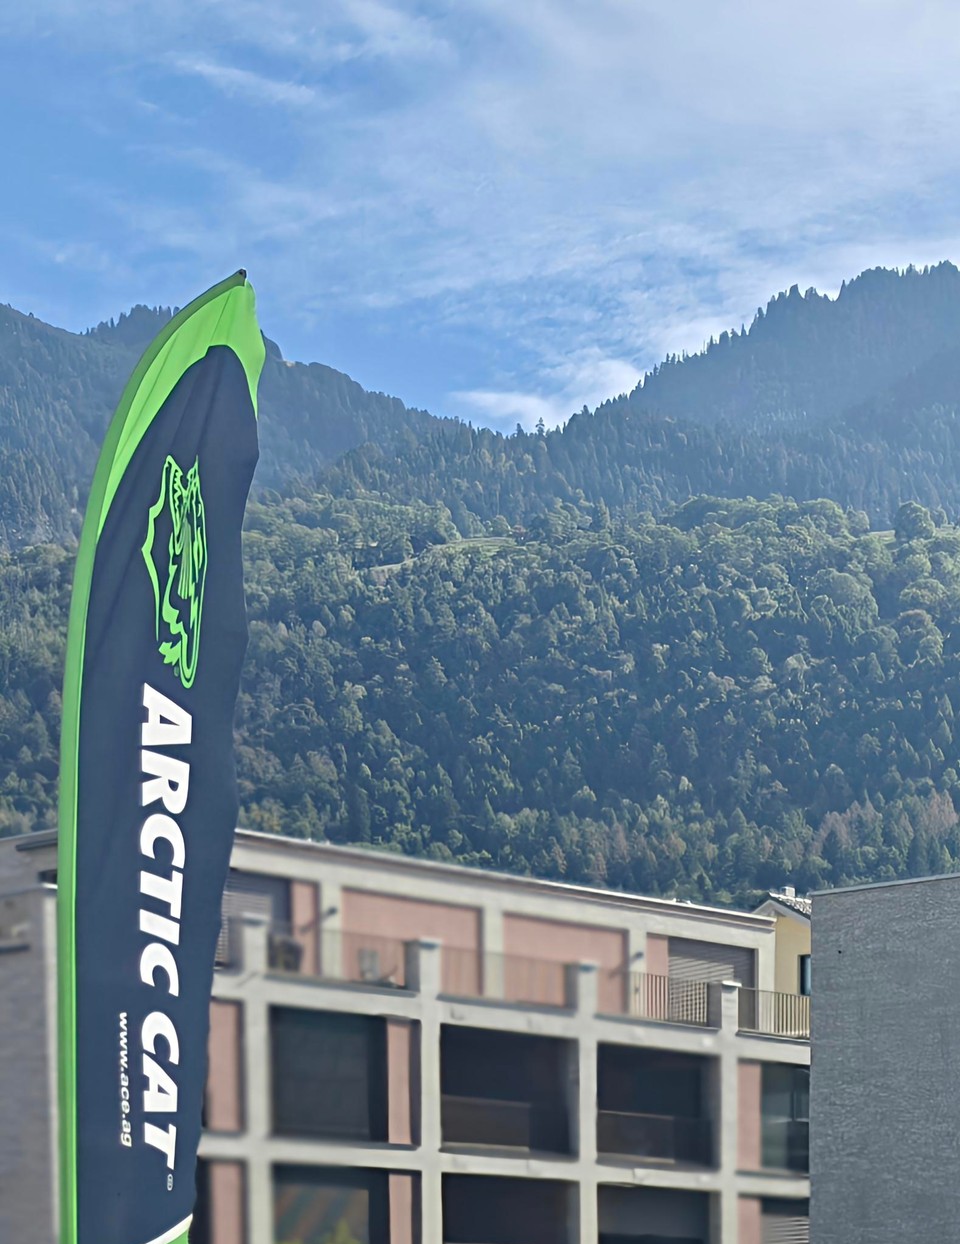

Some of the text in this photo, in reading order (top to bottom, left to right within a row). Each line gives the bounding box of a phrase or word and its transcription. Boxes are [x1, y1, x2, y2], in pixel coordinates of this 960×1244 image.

[119, 1011, 133, 1148] www.ace.ag
[139, 681, 194, 1170] ARCTIC CAT
